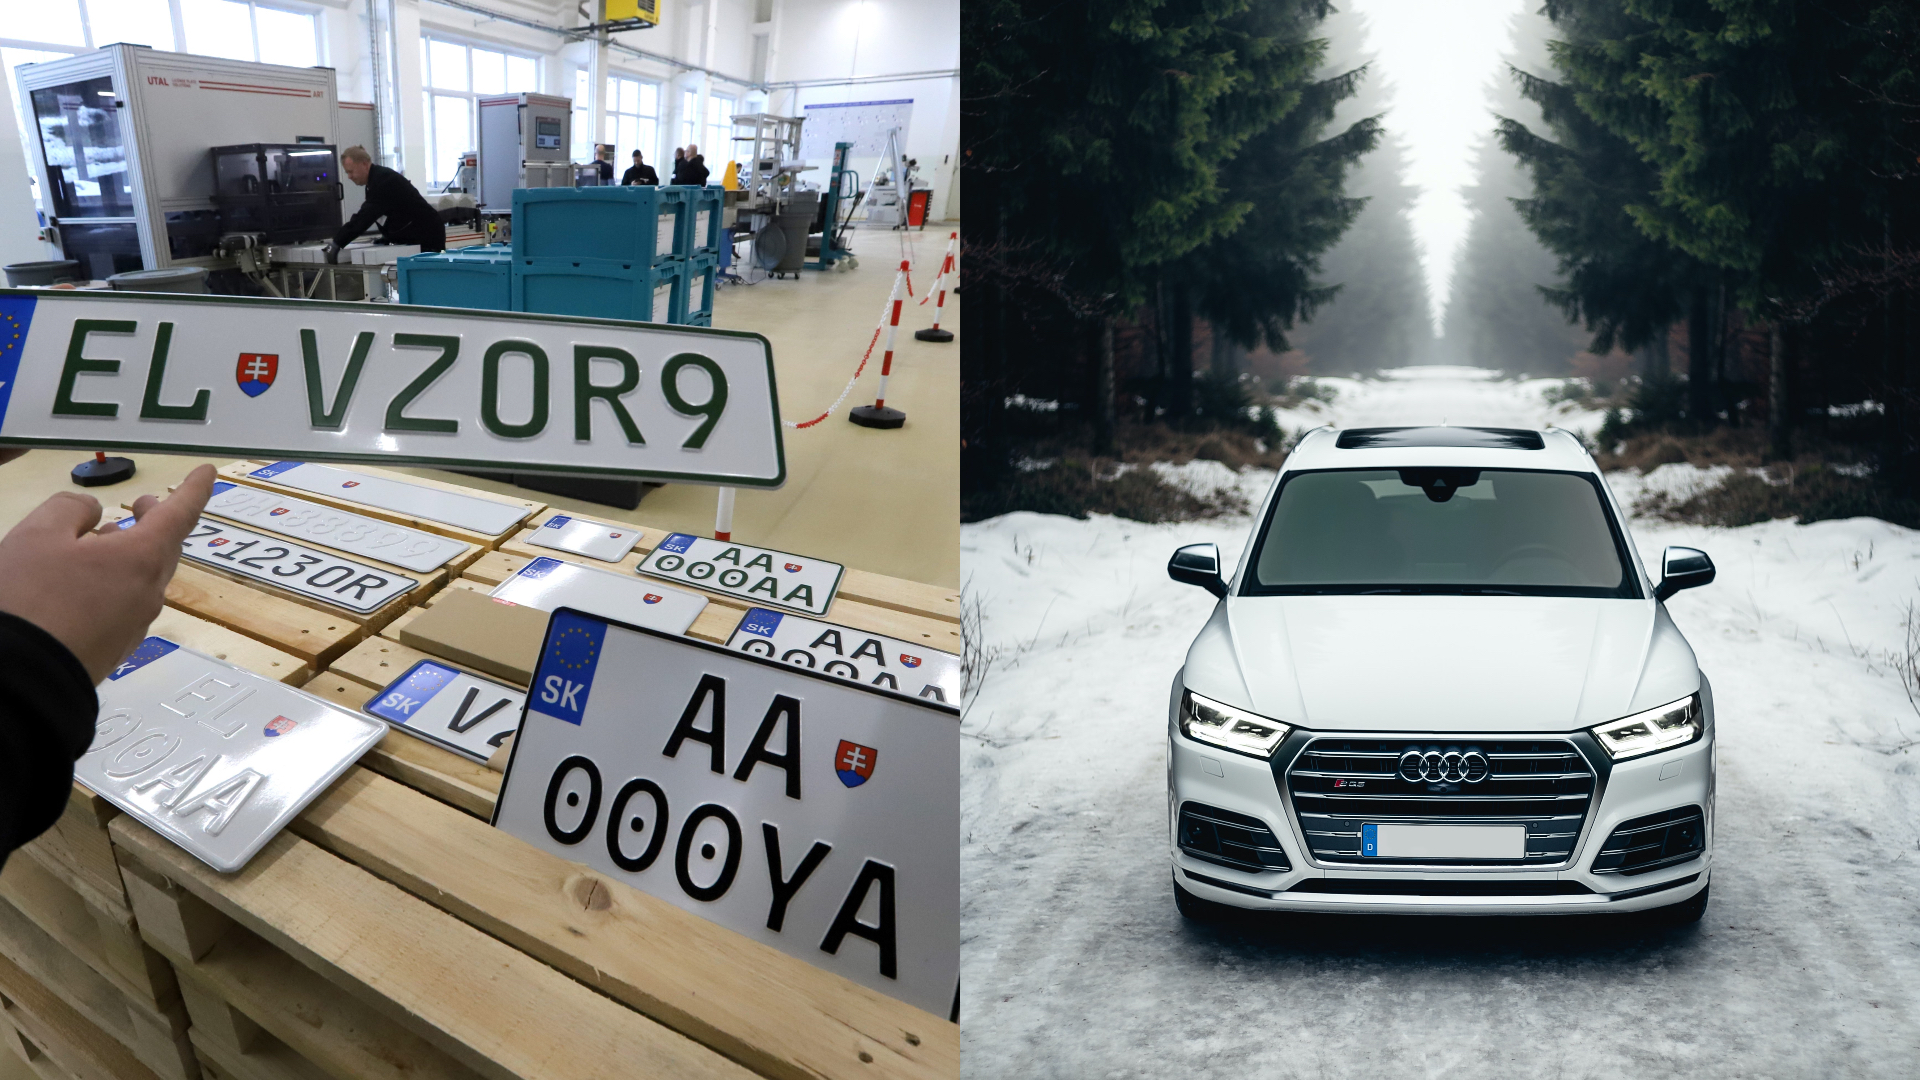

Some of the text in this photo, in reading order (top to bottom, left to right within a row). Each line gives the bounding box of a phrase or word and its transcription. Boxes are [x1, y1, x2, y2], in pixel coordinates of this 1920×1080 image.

[147, 76, 169, 86] UTAL
[313, 90, 323, 98] ART
[51, 318, 212, 421] EL
[257, 469, 277, 477] SK
[182, 525, 223, 547] Z
[663, 542, 685, 554] SK
[713, 547, 773, 574] AA
[523, 568, 546, 579] SK
[746, 622, 771, 636] SK
[809, 628, 886, 667] AA
[160, 671, 258, 740] EL
[382, 692, 421, 715] SK
[540, 674, 585, 713] SK
[447, 687, 523, 748] V
[662, 673, 802, 800] AA
[86, 697, 265, 837] 00AA
